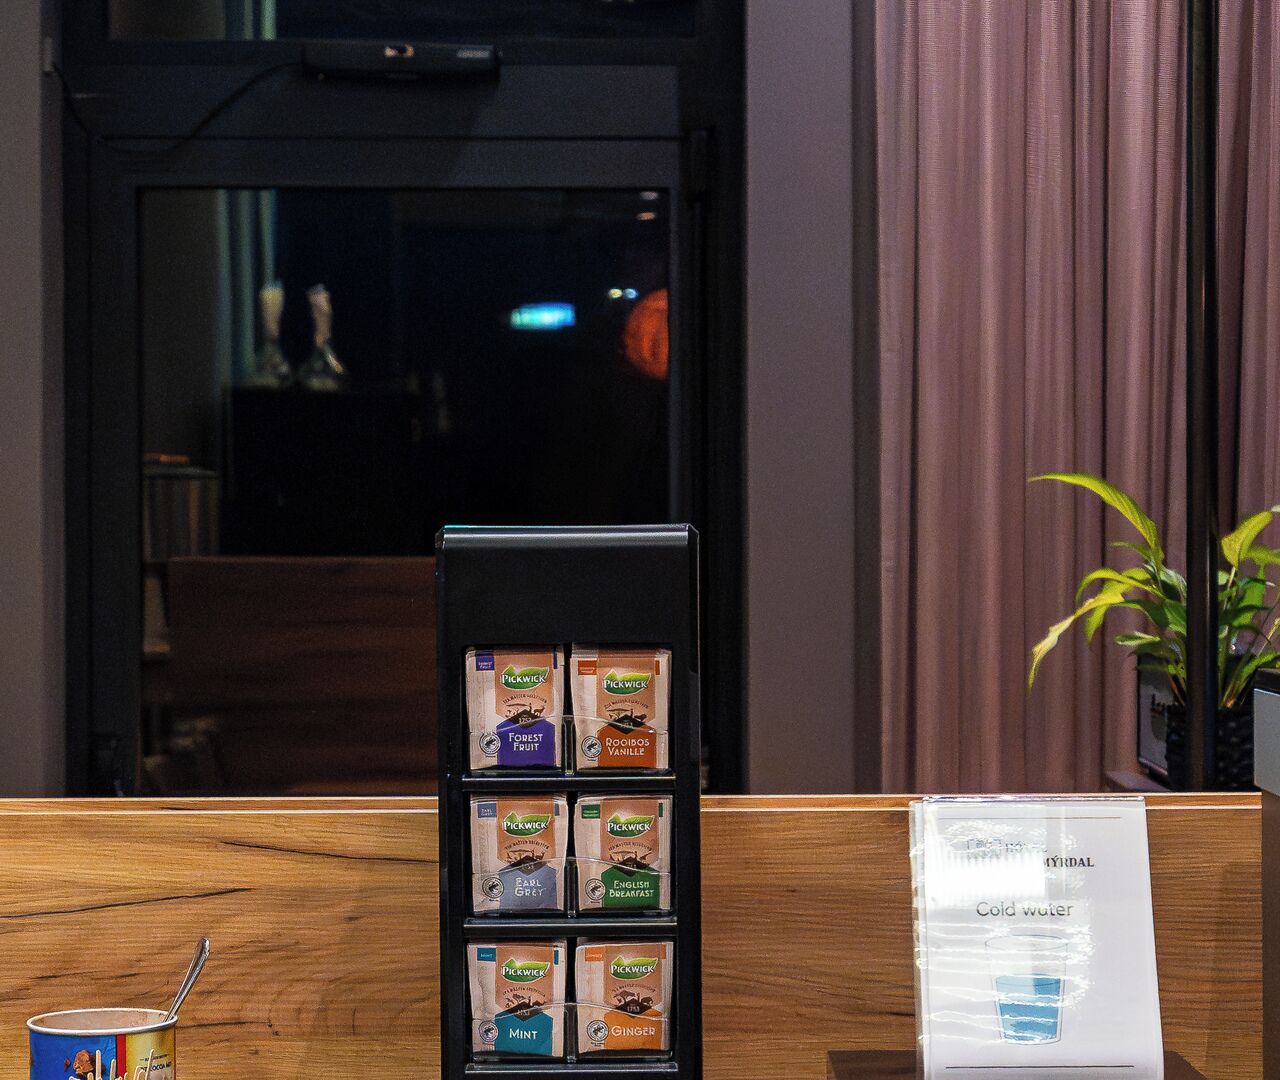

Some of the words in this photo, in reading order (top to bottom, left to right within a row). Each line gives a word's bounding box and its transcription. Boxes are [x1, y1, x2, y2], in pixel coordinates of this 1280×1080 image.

[502, 674, 546, 684] PICKWICK
[604, 680, 647, 688] PICKWICK
[508, 732, 544, 742] FOREST
[606, 738, 650, 746] ROOIBOS
[514, 743, 540, 751] FRUIT
[608, 747, 645, 756] VANILLE
[504, 822, 547, 830] PICKWICK
[608, 823, 651, 832] PICKWICK
[516, 878, 542, 887] EARL
[614, 880, 650, 889] ENGLISH
[514, 887, 544, 896] GREY
[610, 889, 654, 898] BREAKFAST
[976, 901, 1016, 917] Cold
[1022, 902, 1074, 917] water
[502, 967, 546, 976] PICKWICK
[611, 965, 654, 974] PICKWICK
[509, 1029, 538, 1040] MINT
[611, 1026, 656, 1036] GINGER
